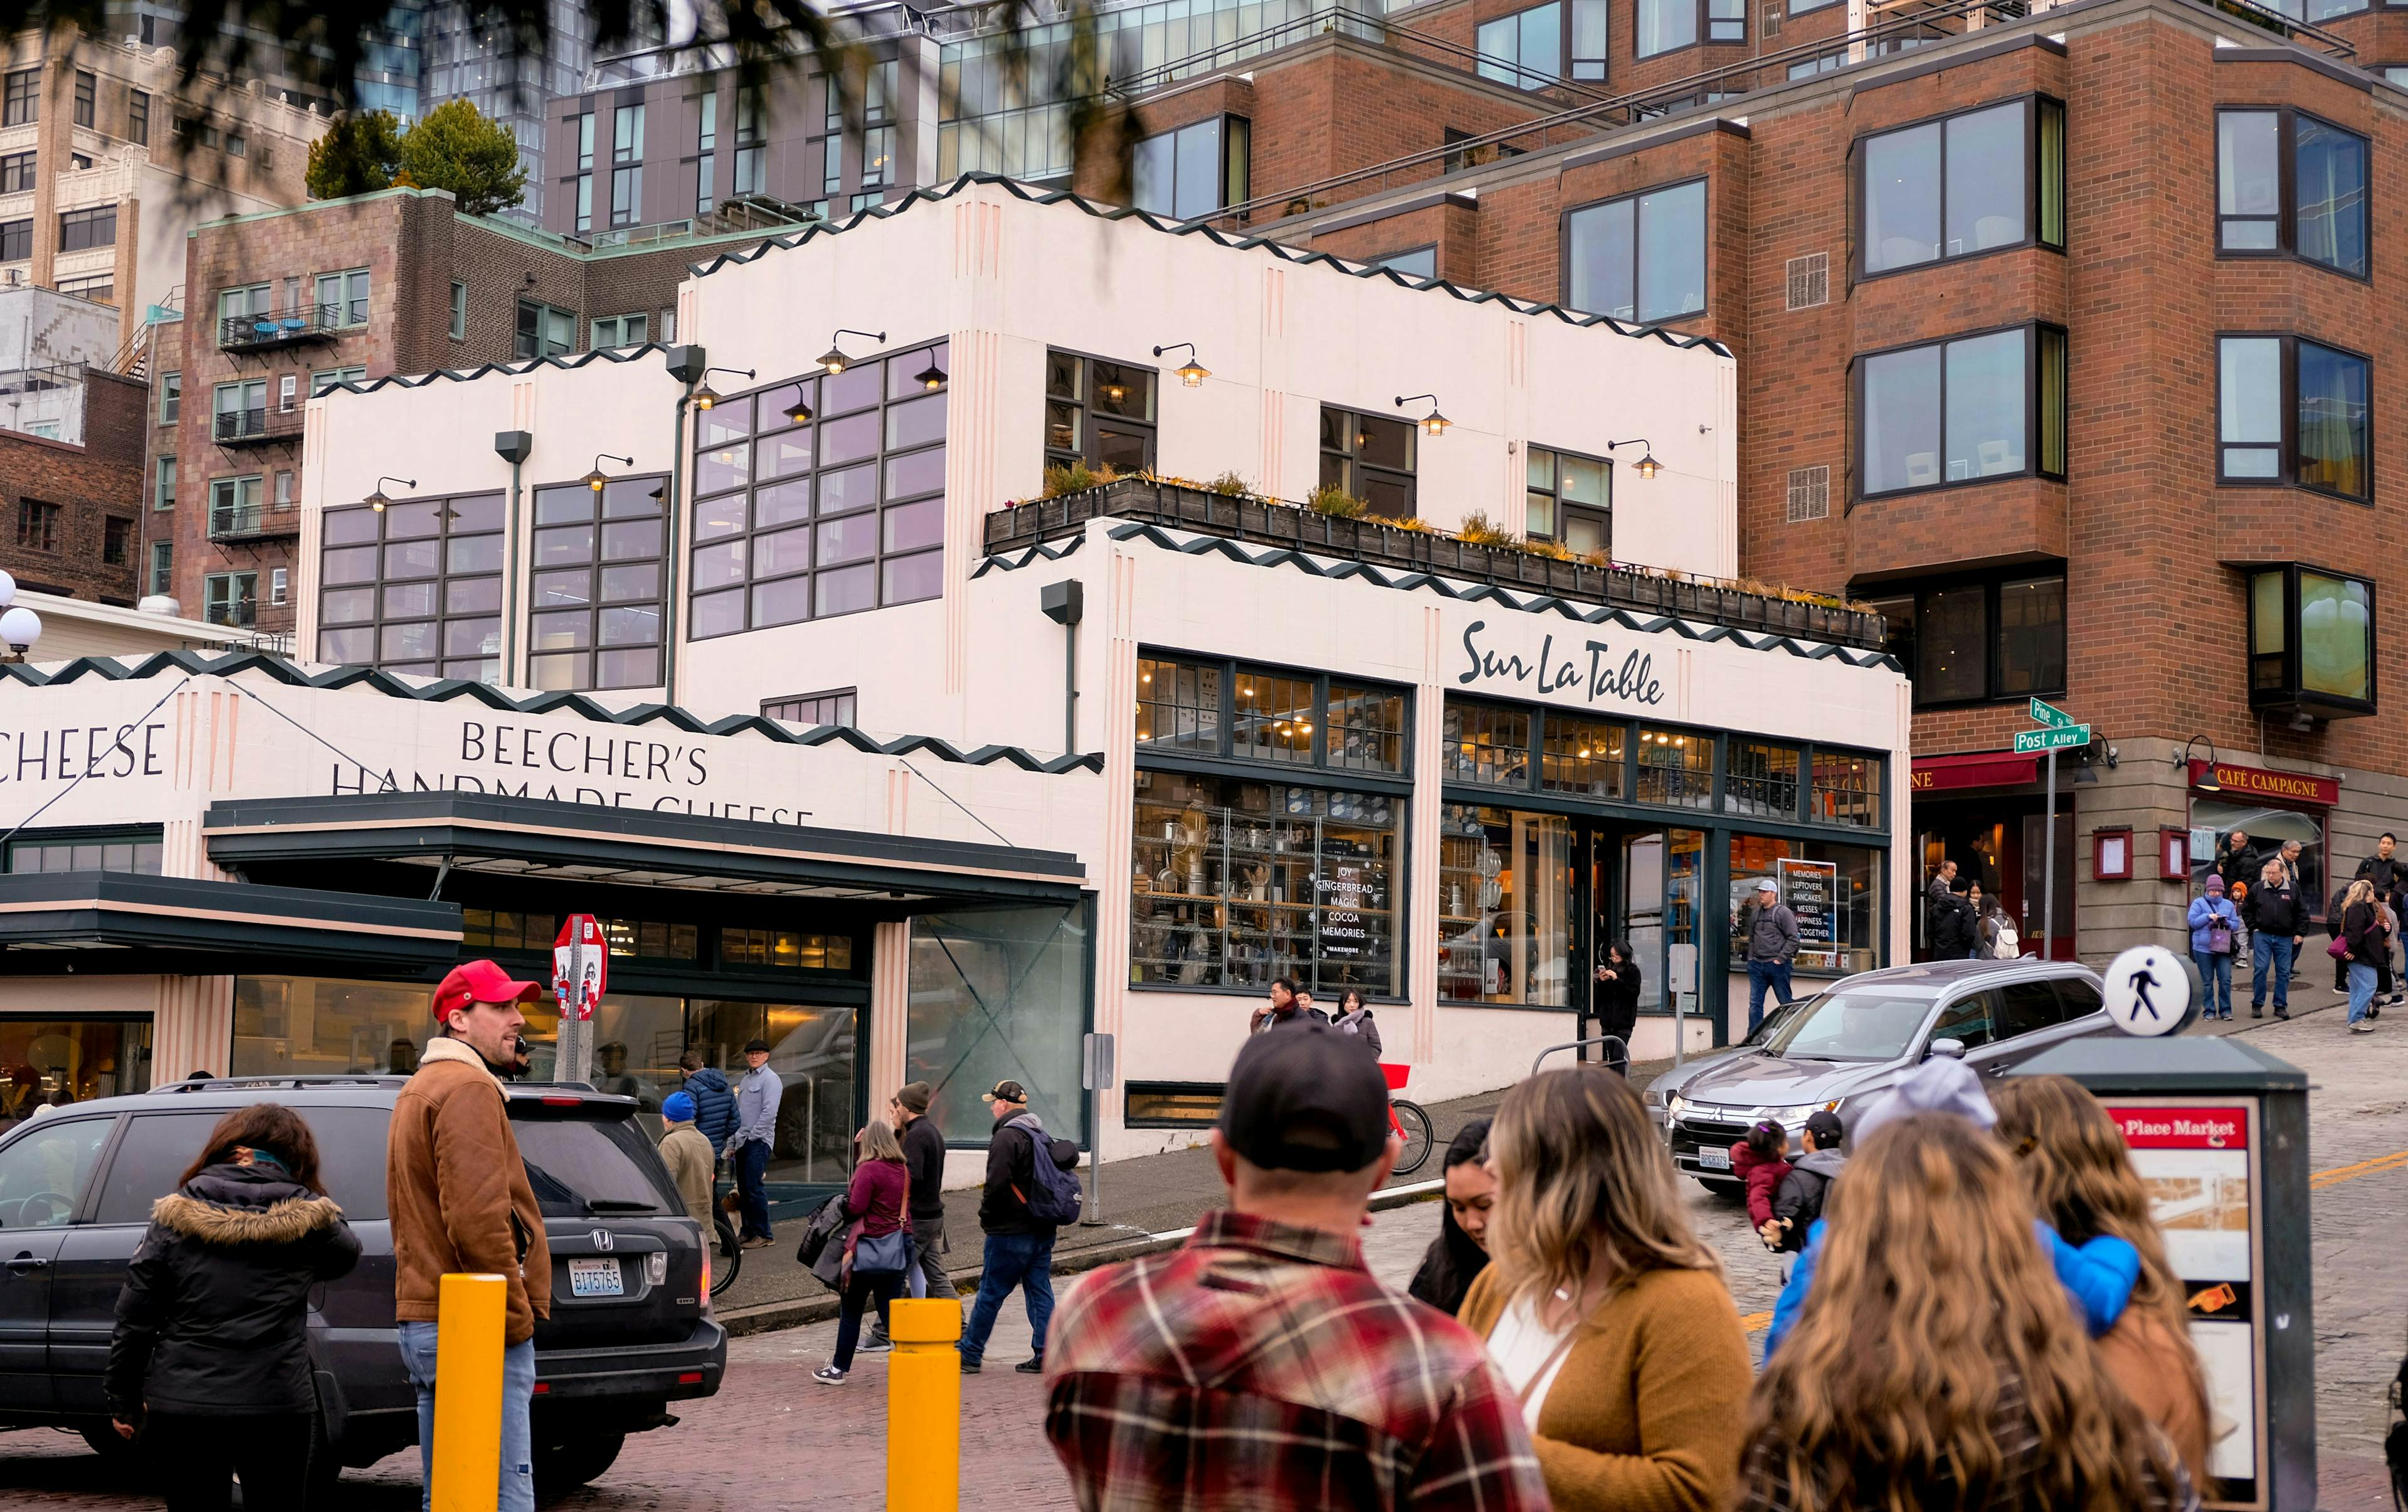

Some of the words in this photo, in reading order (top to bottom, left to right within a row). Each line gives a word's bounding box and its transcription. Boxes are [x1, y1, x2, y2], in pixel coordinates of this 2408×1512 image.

[1459, 620, 1533, 684] Sur
[1538, 634, 1583, 694] La
[1586, 640, 1665, 705] Table
[2034, 701, 2051, 723] Pine
[2057, 717, 2063, 727] St
[2018, 732, 2046, 749] Post
[2052, 733, 2078, 745] Alley
[462, 722, 707, 786] BEECHER'S
[2217, 769, 2248, 787] CAFÉ
[2251, 773, 2318, 798] CAMPAGNE
[1337, 867, 1353, 878] JOY
[1793, 870, 1822, 879] MEMORIES
[1316, 880, 1373, 894] GINGERBREAD
[1792, 882, 1822, 891] LEFTOVERS
[1331, 896, 1358, 907] MAGIC
[1793, 893, 1822, 902] PANCAKES
[1797, 905, 1818, 914] MESSES
[1328, 912, 1360, 923] COCOA
[1322, 926, 1365, 939] MEMORIES
[1800, 928, 1829, 938] TOGETHER
[1326, 946, 1359, 954] #MAKEMORE
[2125, 1119, 2172, 1136] Place
[2172, 1119, 2236, 1136] Market
[574, 1271, 620, 1290] BIT5765
